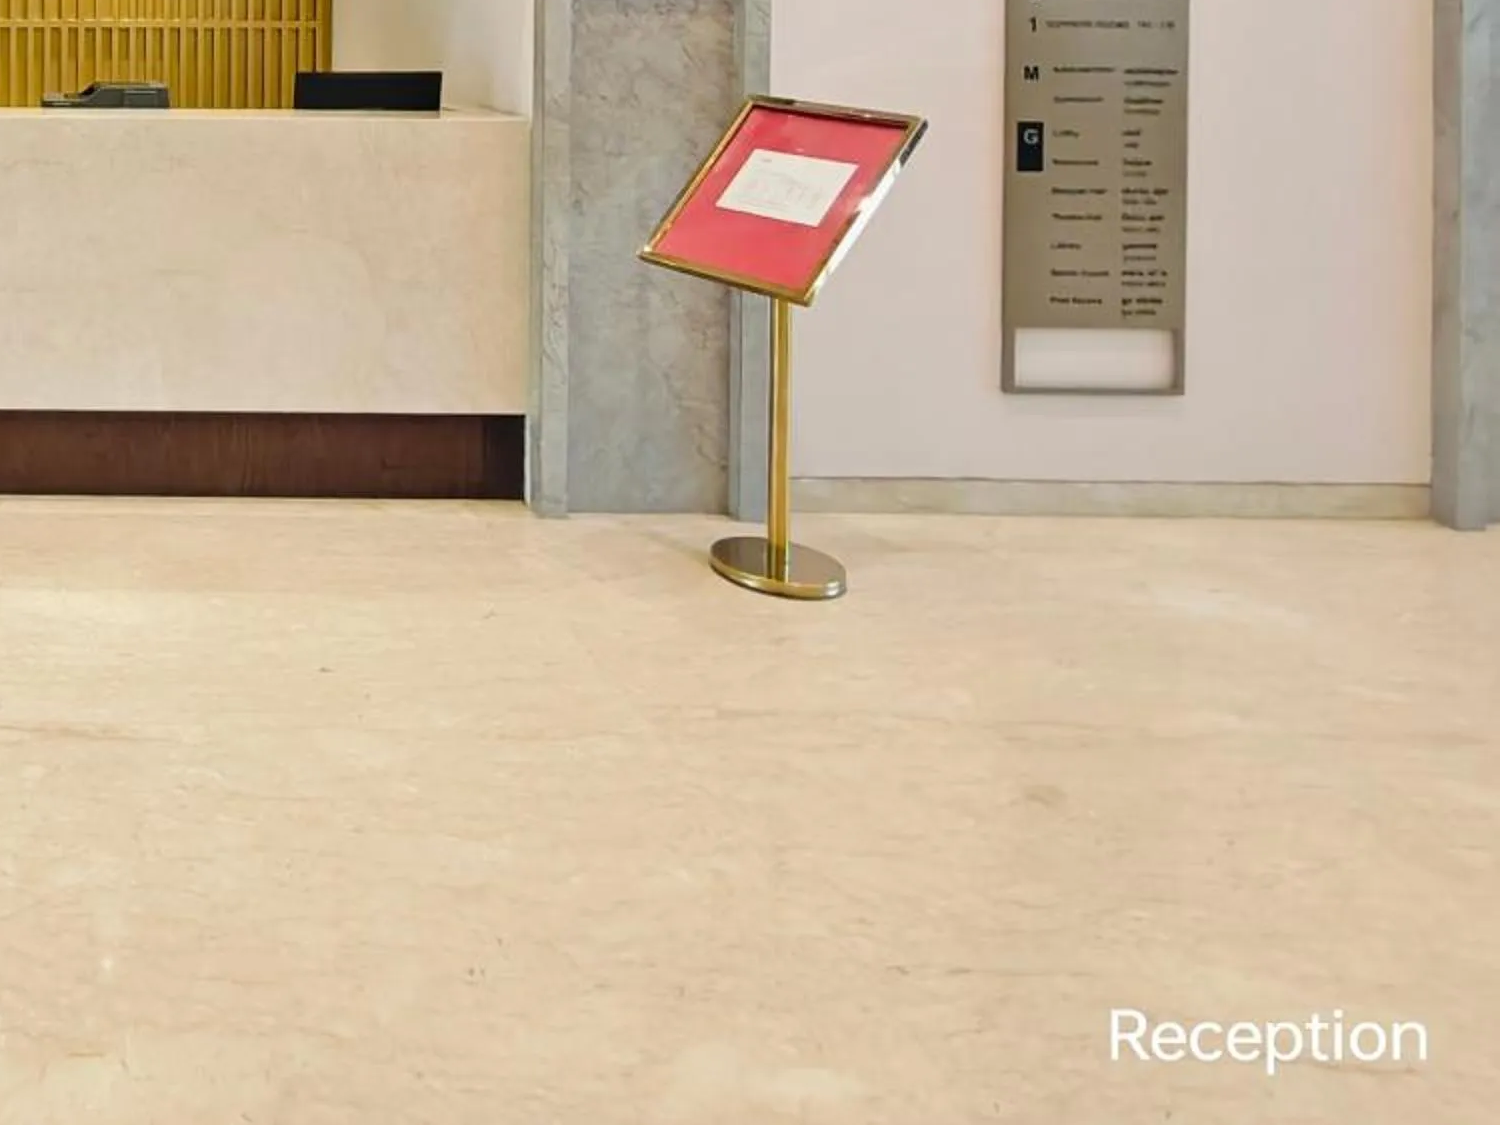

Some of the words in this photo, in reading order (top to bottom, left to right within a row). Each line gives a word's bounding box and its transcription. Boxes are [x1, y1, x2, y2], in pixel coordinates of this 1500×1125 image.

[1029, 17, 1038, 32] 1
[1024, 65, 1039, 80] M
[1023, 129, 1040, 144] G
